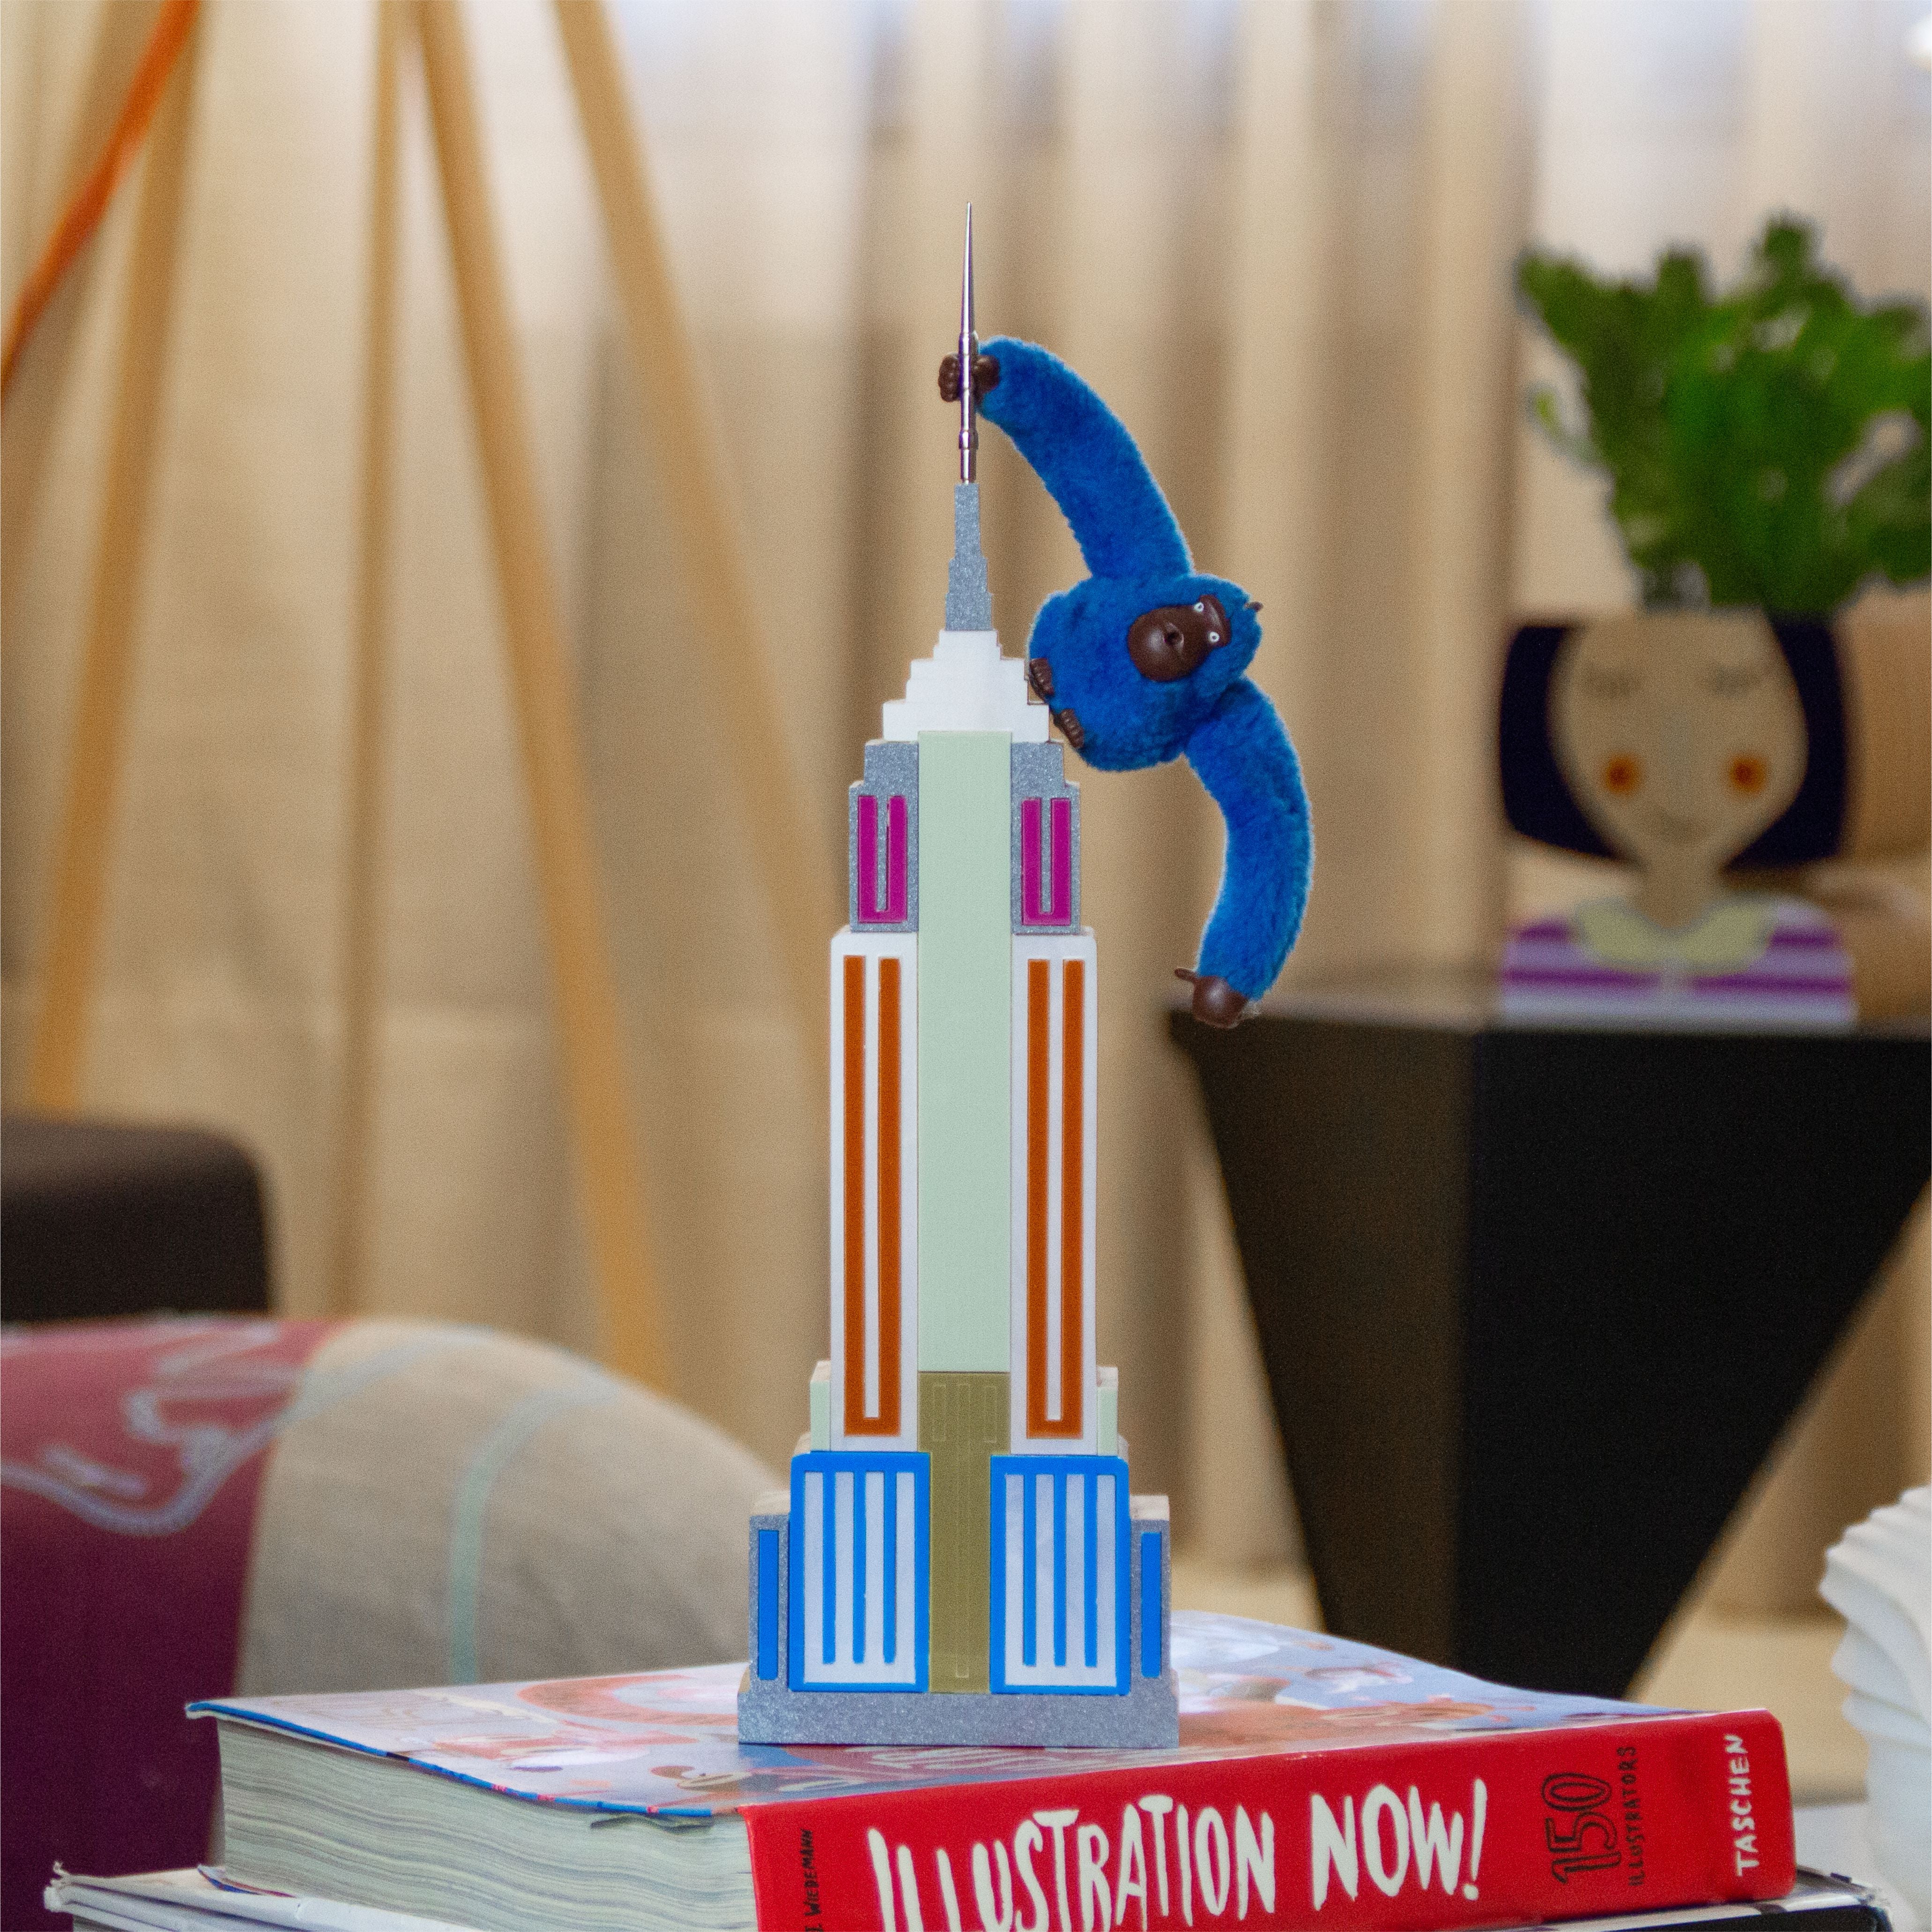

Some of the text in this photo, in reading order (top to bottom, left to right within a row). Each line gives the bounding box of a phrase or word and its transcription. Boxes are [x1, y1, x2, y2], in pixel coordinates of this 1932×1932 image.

[1312, 1779, 1487, 1910] NOW!
[1541, 1772, 1621, 1884] 150
[1617, 1747, 1645, 1886] ILLUSTRATORS
[1724, 1734, 1760, 1876] TASCHEN
